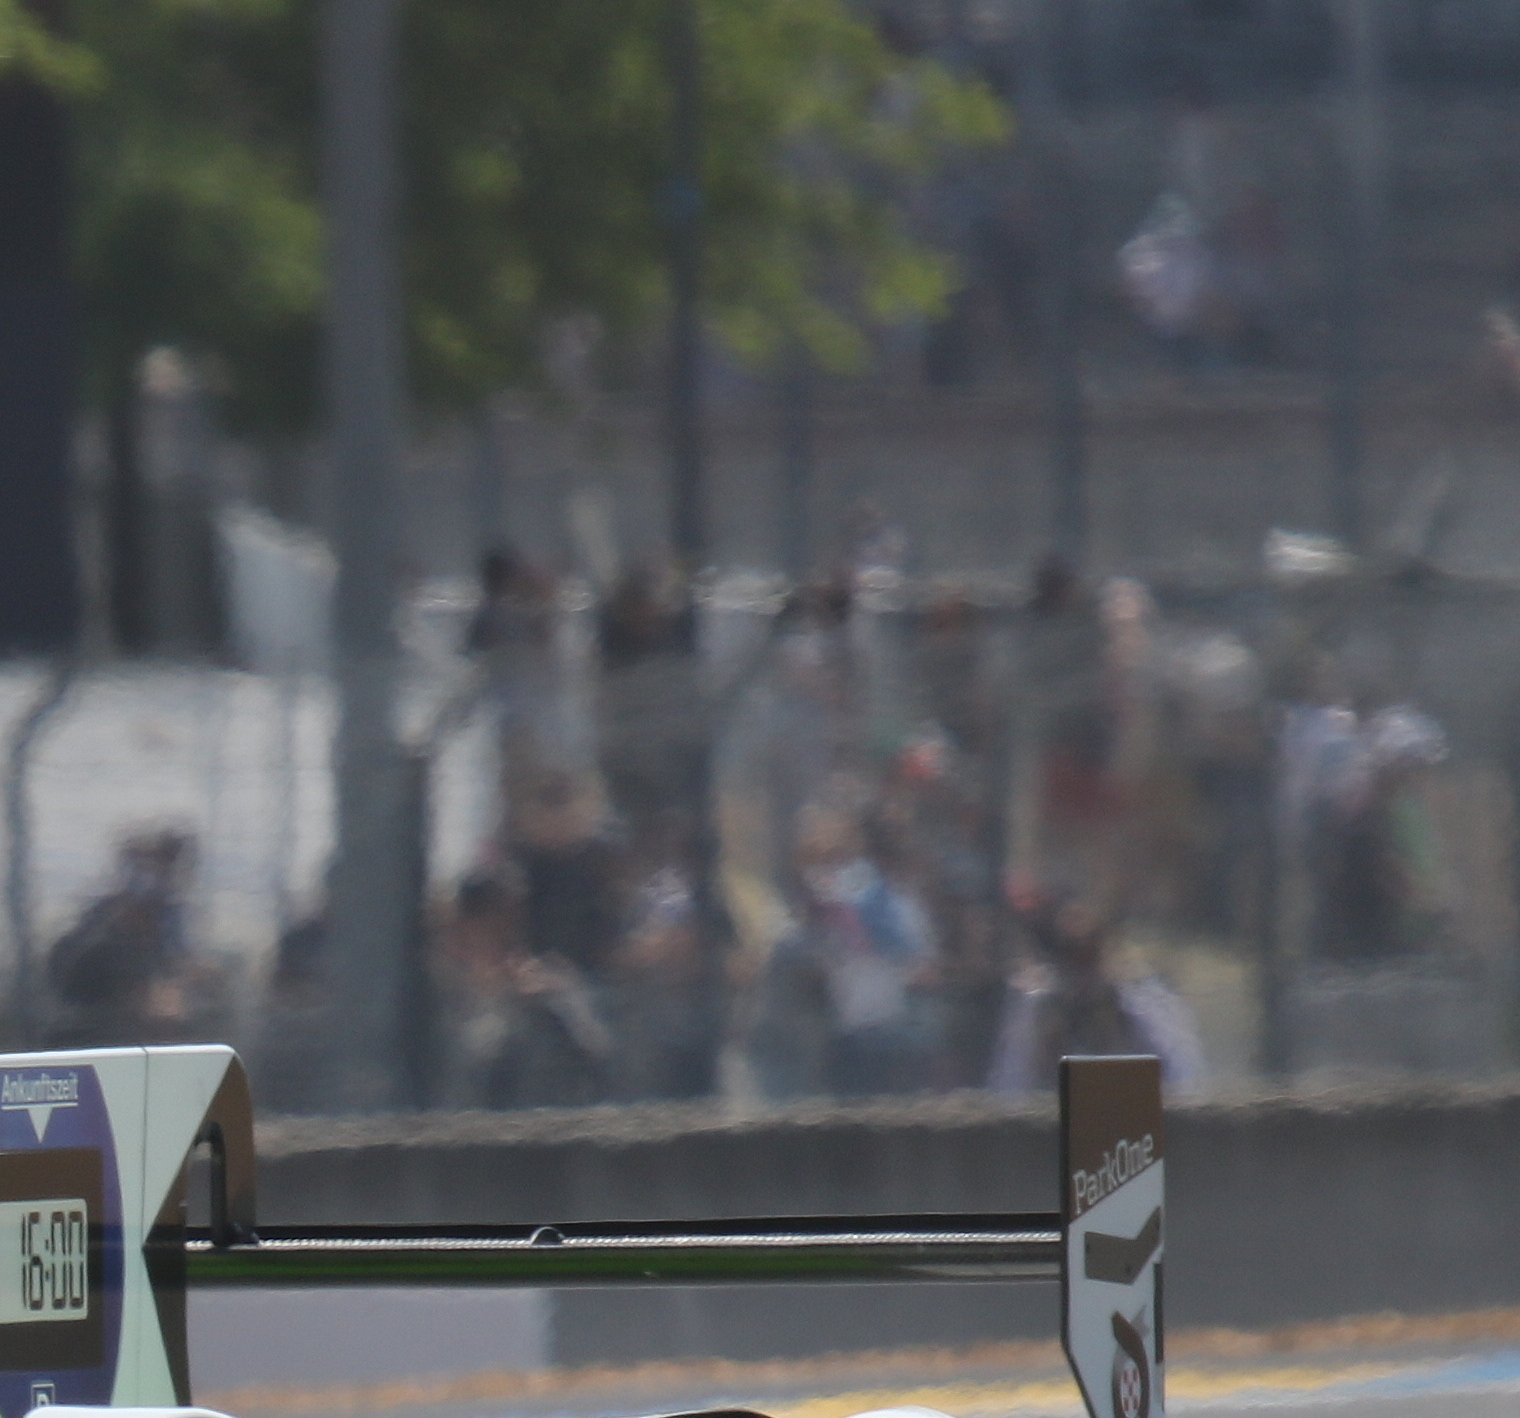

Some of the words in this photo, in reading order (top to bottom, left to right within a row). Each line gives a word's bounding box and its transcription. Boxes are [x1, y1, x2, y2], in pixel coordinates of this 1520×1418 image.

[1, 1072, 79, 1103] Ankunftszeit
[1072, 1132, 1155, 1216] ParkOne
[21, 1211, 84, 1311] 16:00
